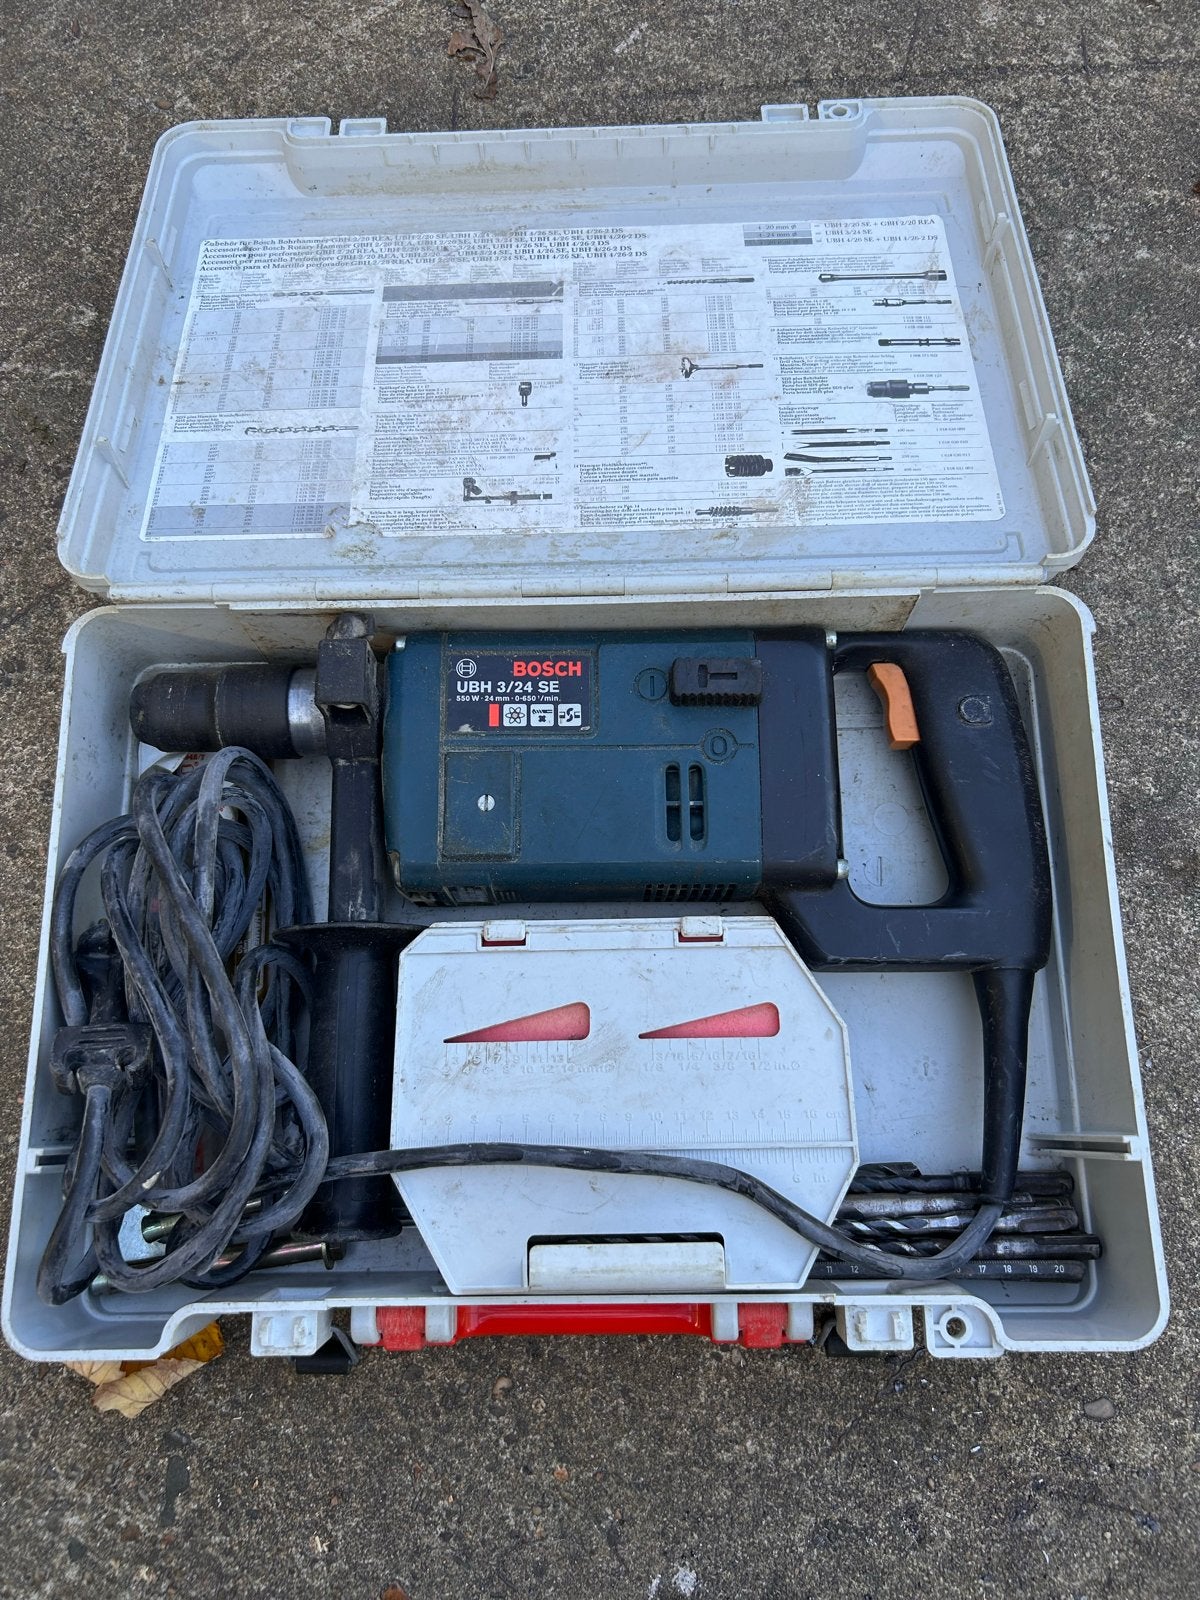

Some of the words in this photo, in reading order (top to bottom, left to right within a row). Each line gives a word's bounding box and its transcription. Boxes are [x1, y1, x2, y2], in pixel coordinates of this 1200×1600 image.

[279, 237, 330, 245] Bohrhammer
[288, 244, 314, 253] Rotary
[269, 250, 313, 258] perforateur
[243, 264, 261, 272] para
[306, 261, 349, 269] perforador
[513, 661, 582, 677] BOSCH
[456, 680, 492, 693] UBH
[497, 680, 533, 693] 3/24
[538, 680, 560, 693] SE
[792, 1173, 801, 1184] 6
[827, 1265, 833, 1273] 11
[851, 1265, 859, 1273] 12
[978, 1264, 987, 1273] 17
[1003, 1264, 1013, 1273] 18
[1029, 1264, 1038, 1273] 19
[1054, 1264, 1065, 1273] 20
